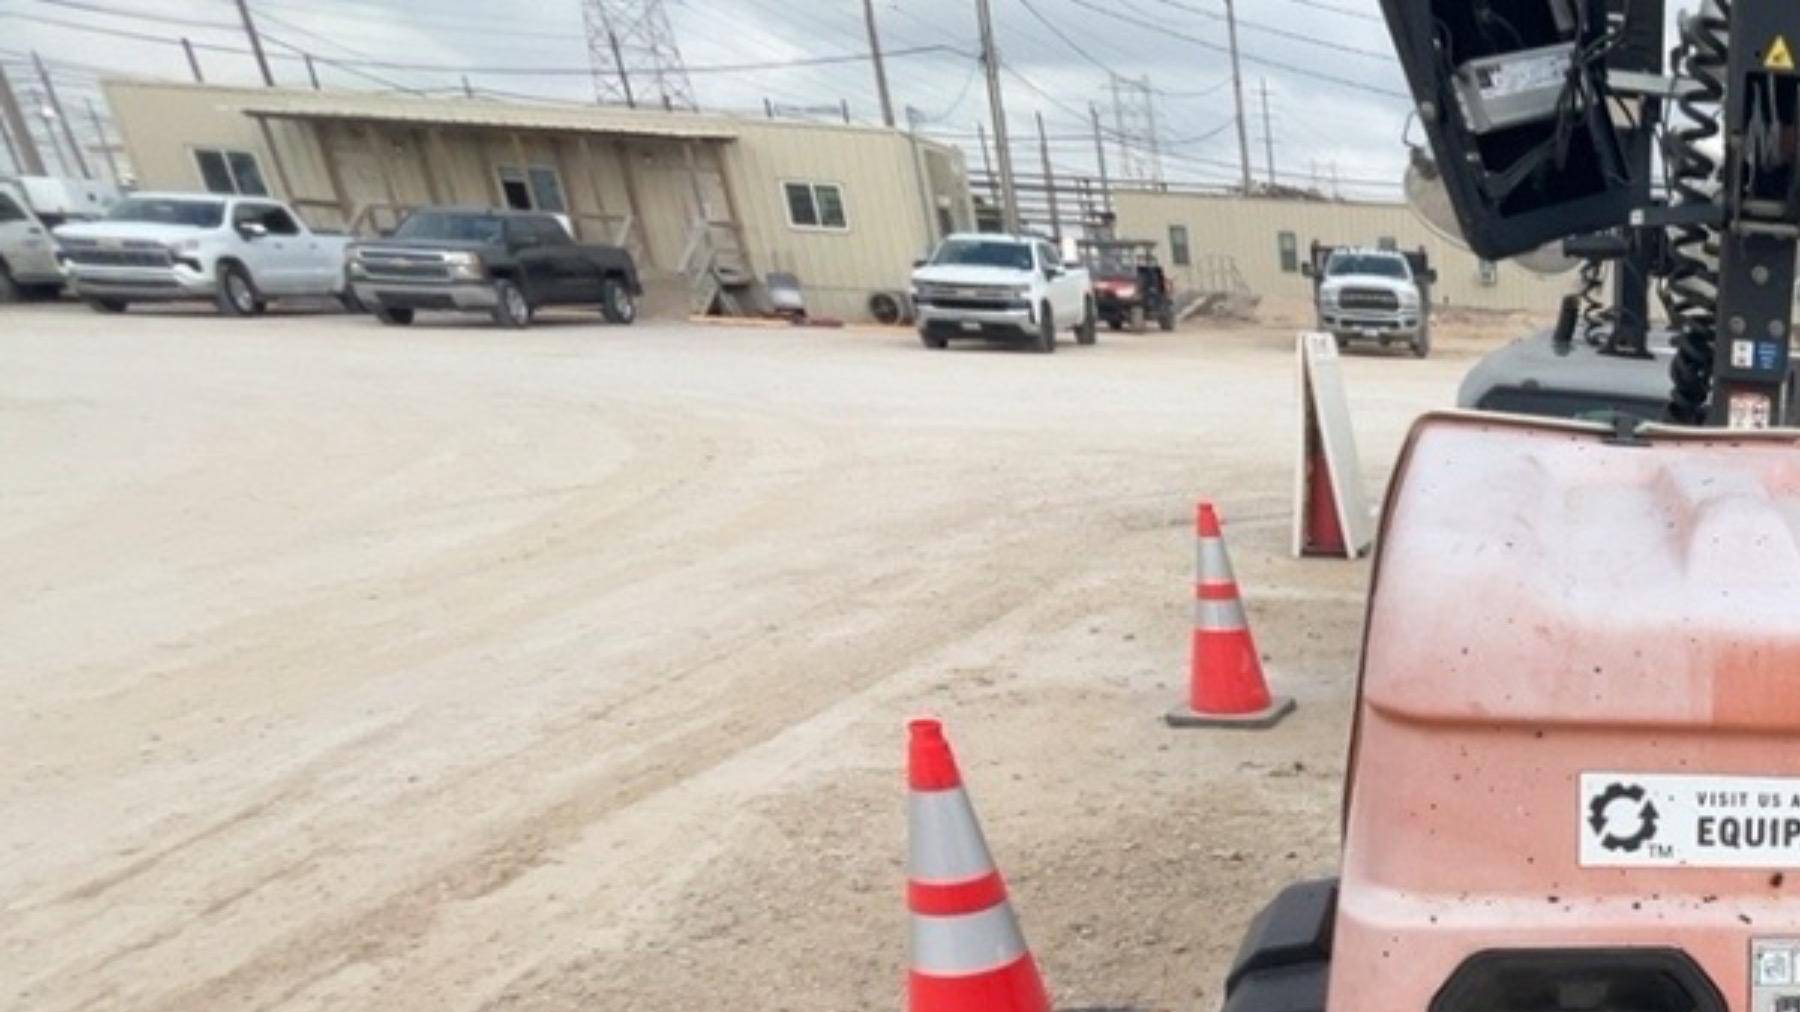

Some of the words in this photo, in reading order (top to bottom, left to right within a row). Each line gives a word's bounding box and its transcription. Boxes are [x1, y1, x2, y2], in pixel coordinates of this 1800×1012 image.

[1697, 792, 1747, 807] VISIT
[1758, 792, 1781, 807] US
[1649, 845, 1673, 858] TM
